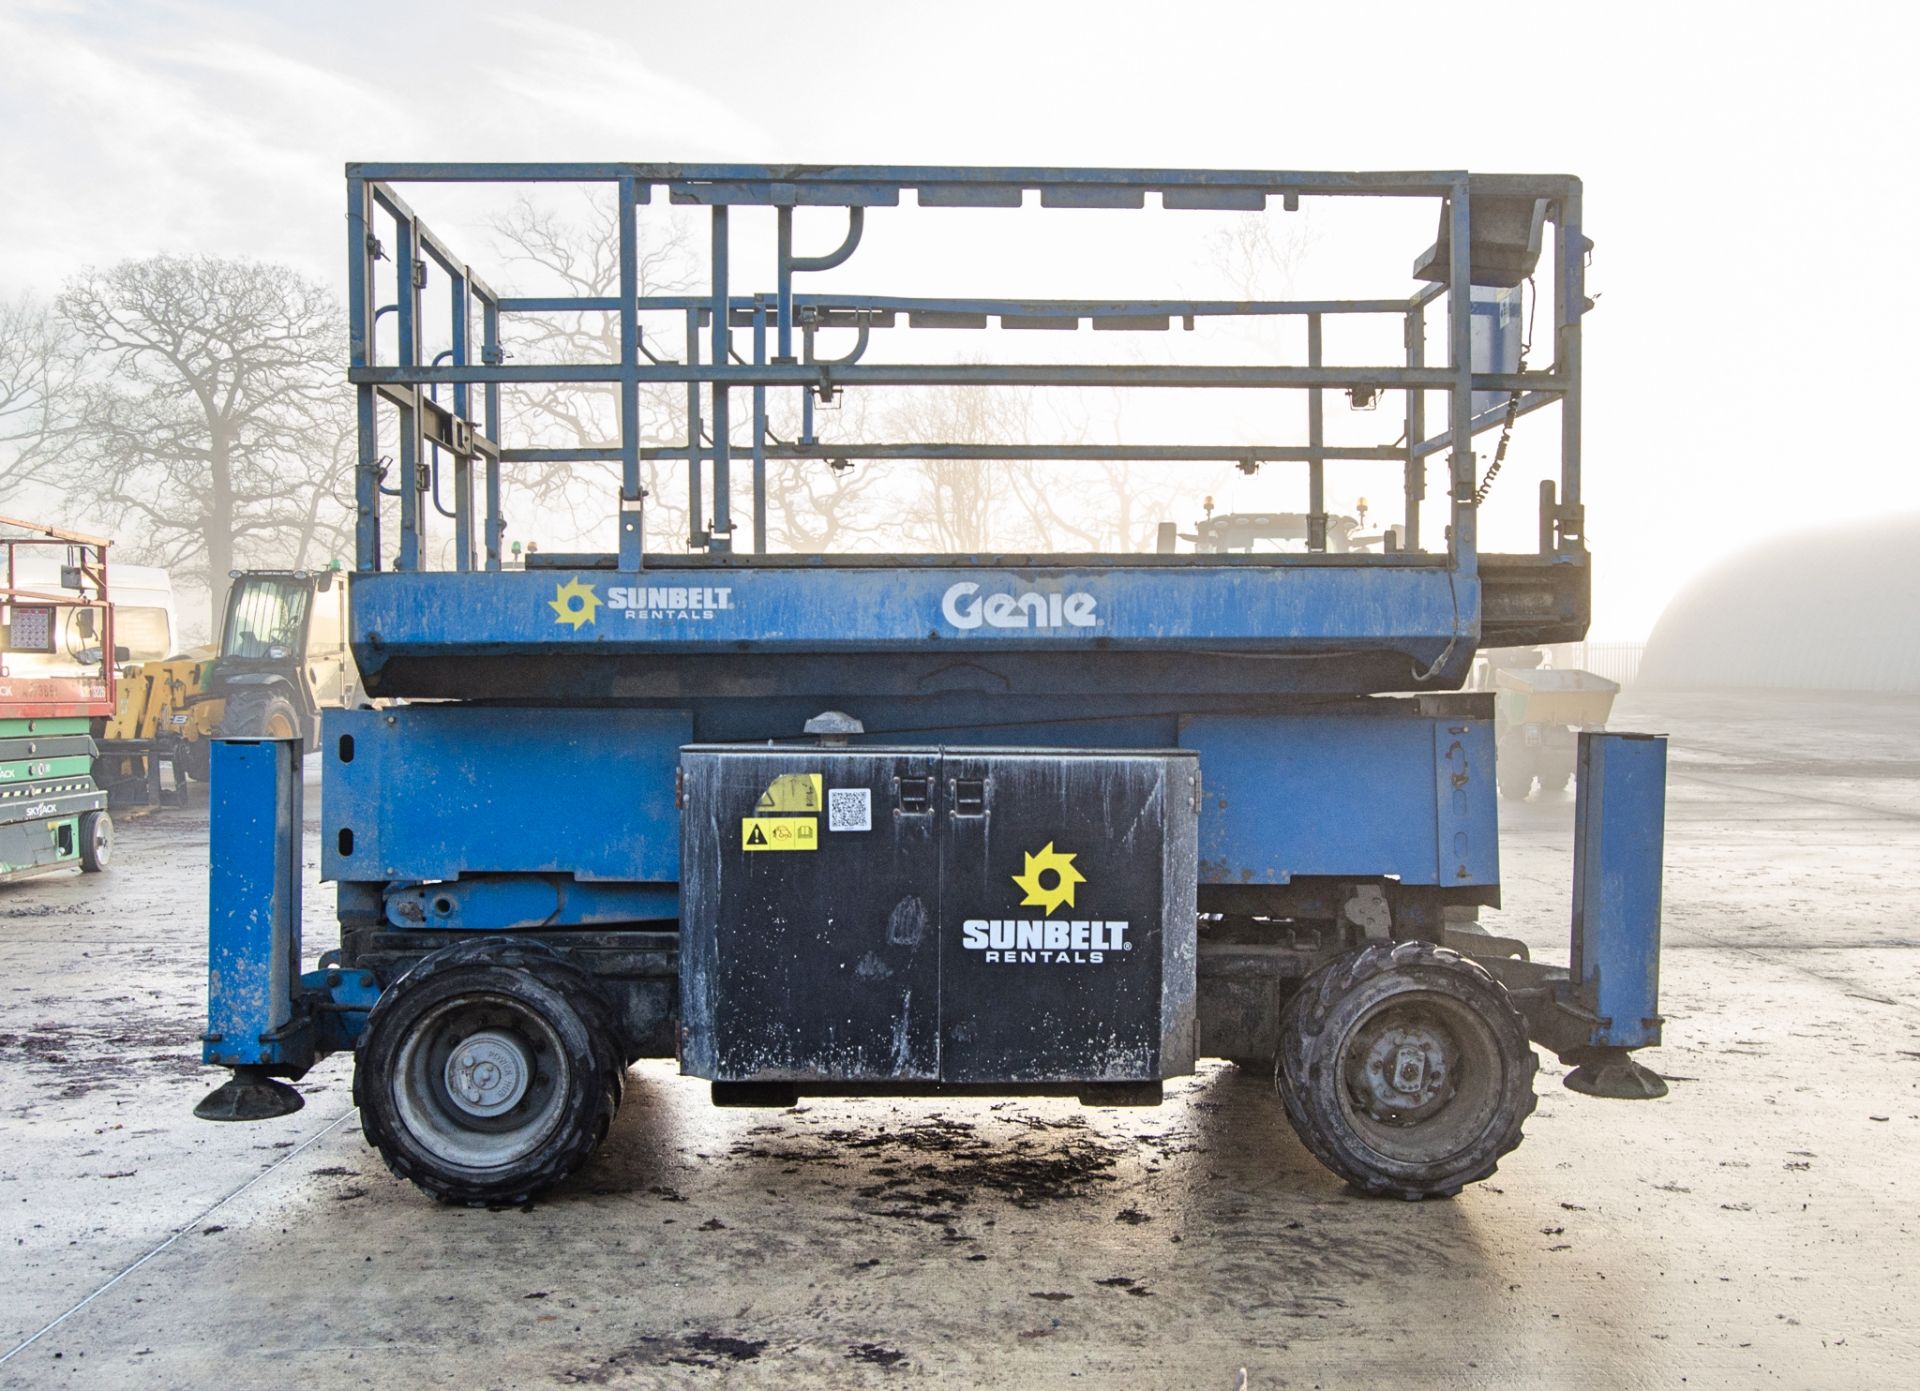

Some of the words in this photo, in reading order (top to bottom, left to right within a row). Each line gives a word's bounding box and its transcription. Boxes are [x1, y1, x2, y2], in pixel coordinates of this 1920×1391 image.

[607, 587, 733, 609] SUNBELT
[942, 582, 1097, 630] Genie
[625, 610, 714, 620] RENTALS
[962, 919, 1129, 951] SUNBELT
[985, 951, 1104, 964] RENTALS
